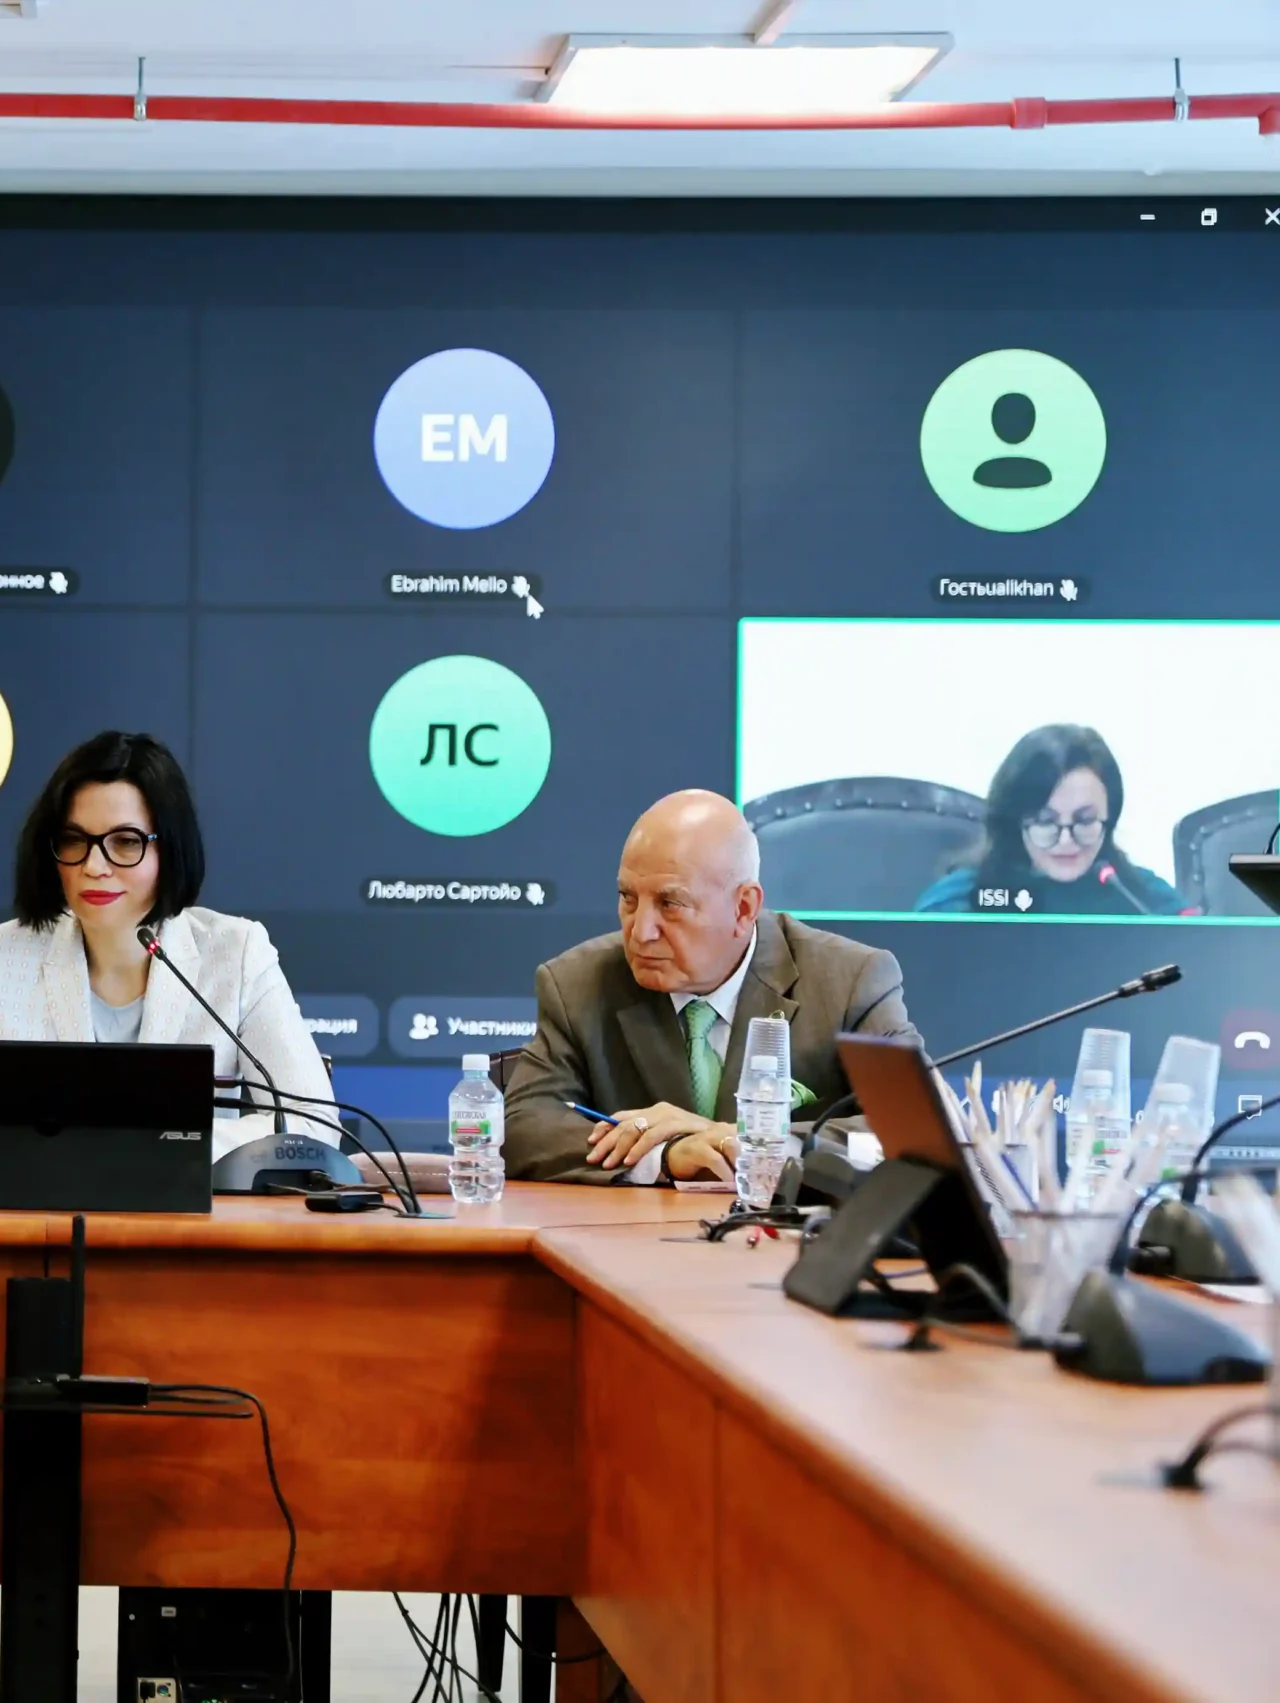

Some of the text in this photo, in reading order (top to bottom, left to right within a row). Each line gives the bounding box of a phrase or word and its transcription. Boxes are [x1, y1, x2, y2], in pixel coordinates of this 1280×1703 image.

[421, 413, 508, 462] EM
[391, 574, 508, 594] Ebrahim Mello
[419, 722, 500, 767] ЛС
[367, 880, 521, 903] Любарто Сартойо
[978, 888, 1010, 907] ISSI
[159, 1131, 202, 1141] ASUS
[274, 1145, 327, 1162] BOSCH
